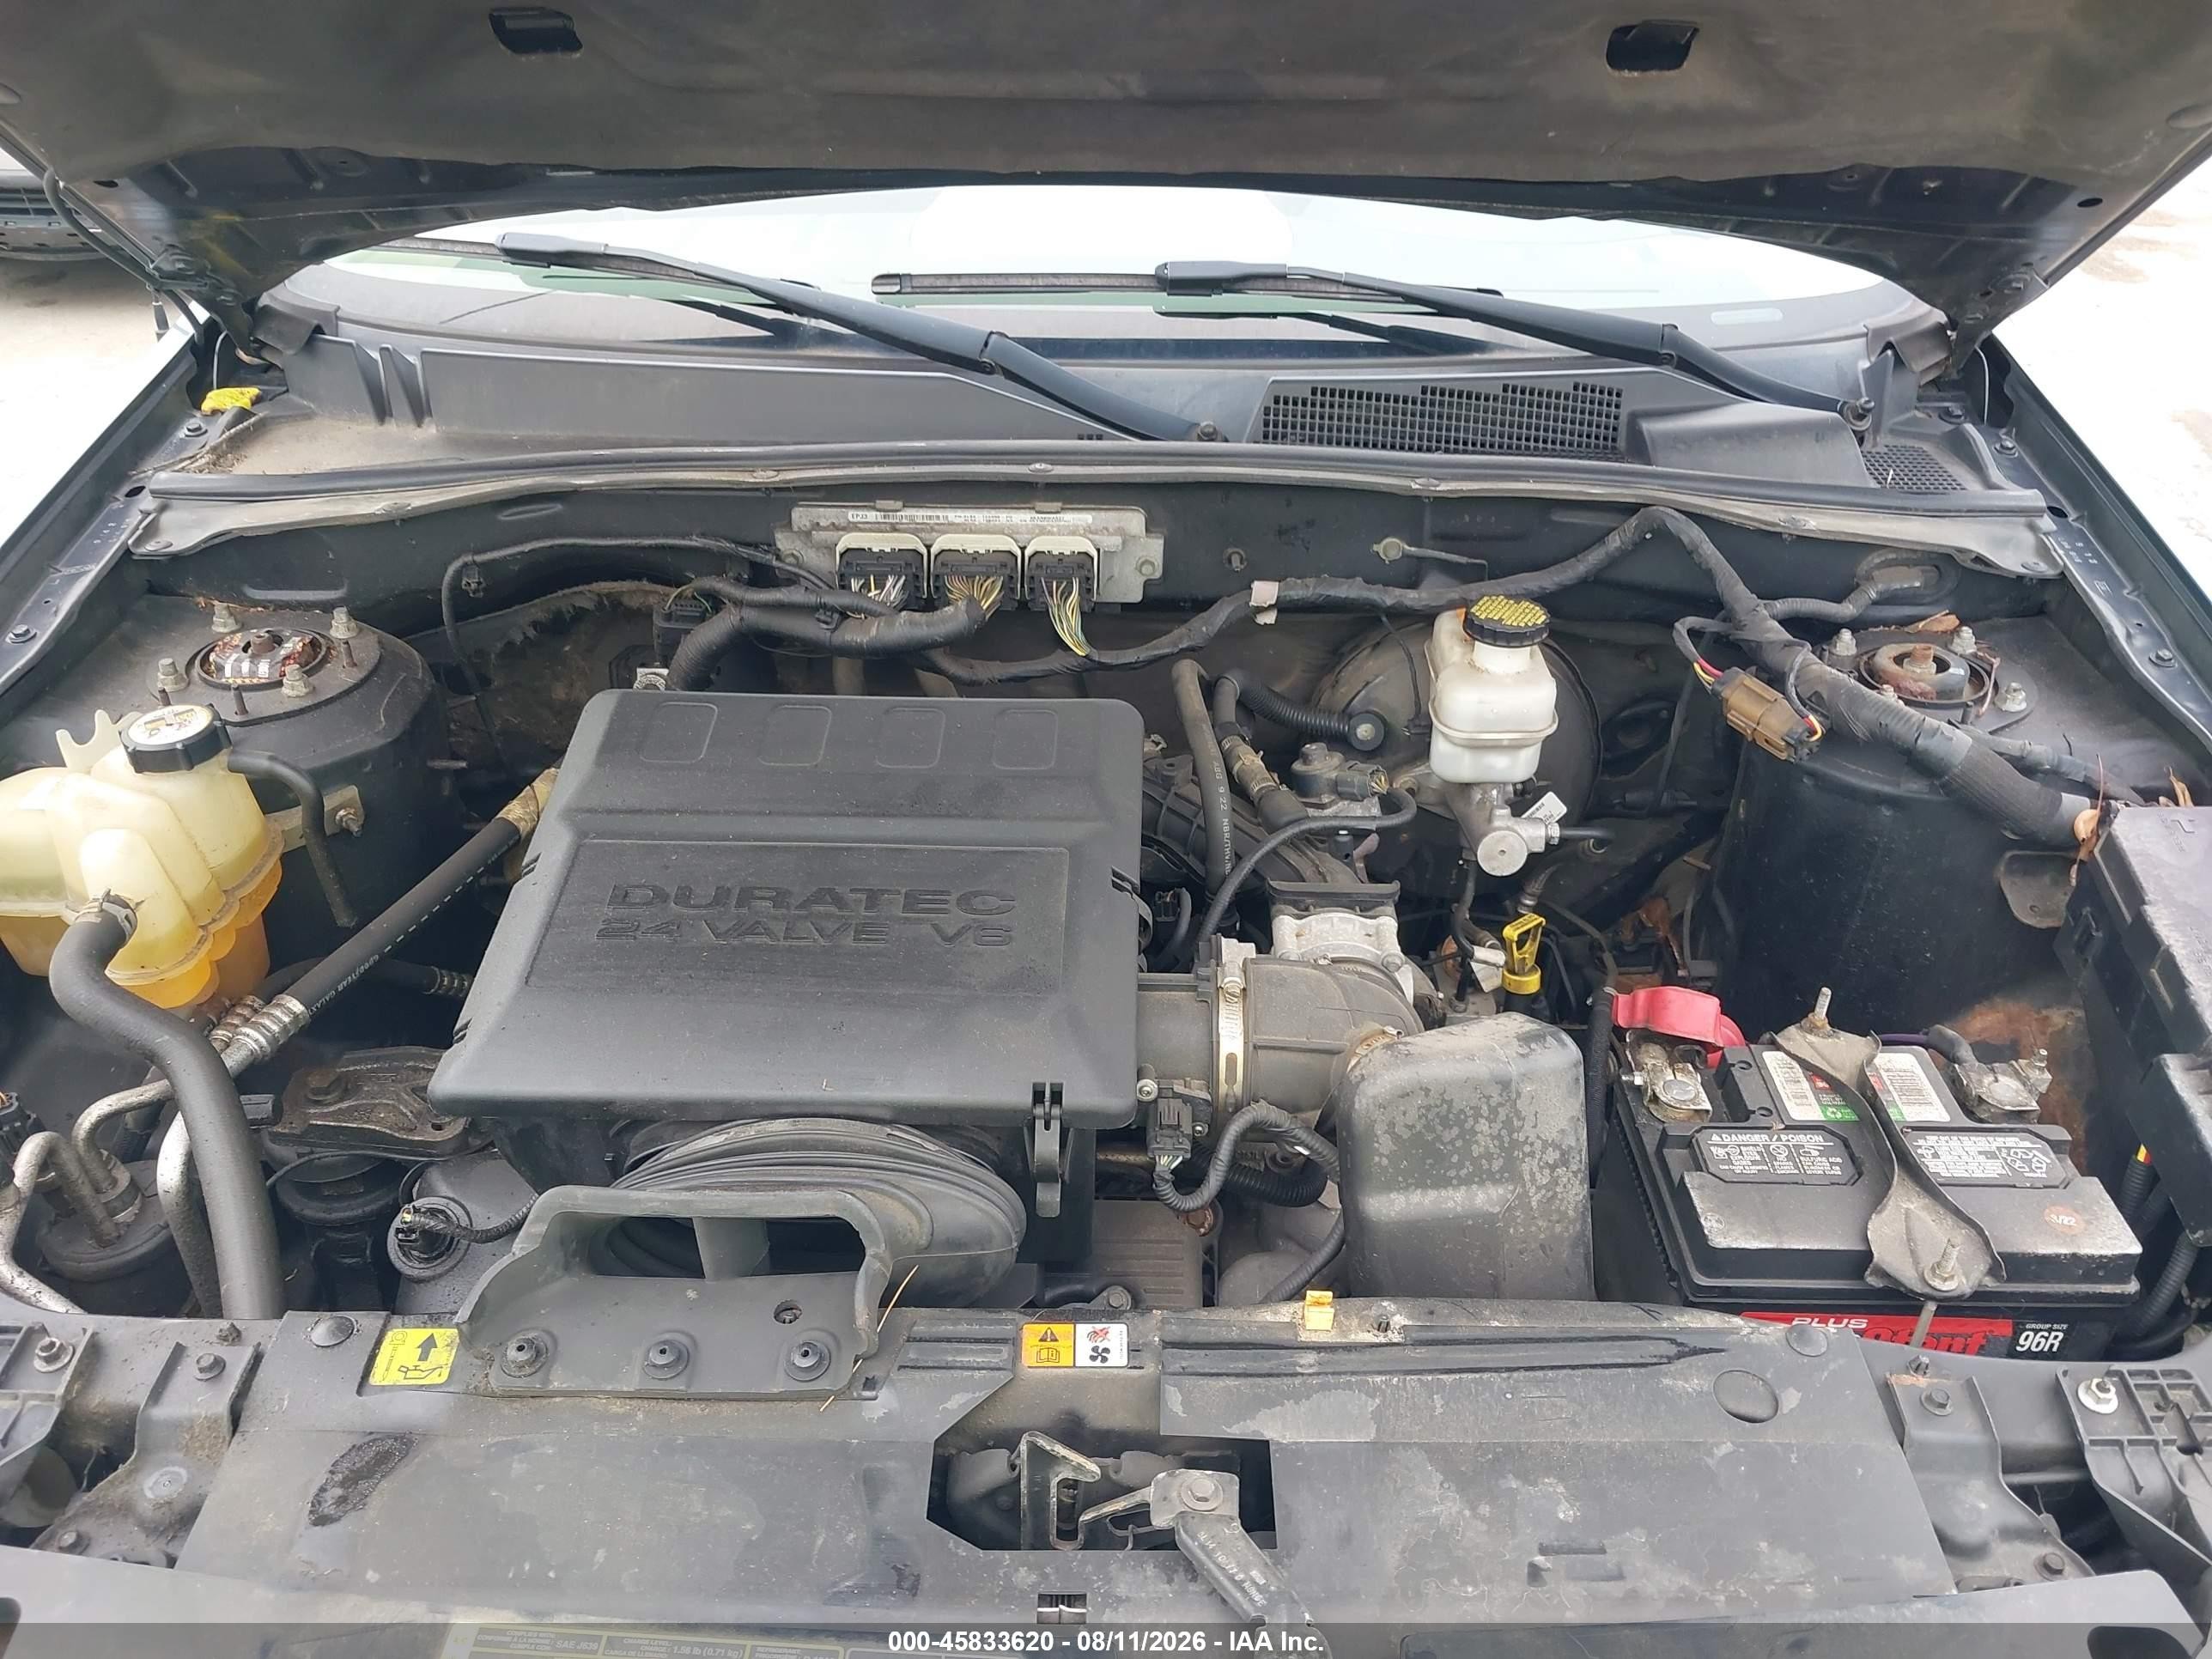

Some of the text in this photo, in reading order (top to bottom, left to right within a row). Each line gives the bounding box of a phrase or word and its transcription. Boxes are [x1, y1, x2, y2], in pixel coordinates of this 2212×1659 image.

[605, 883, 1016, 915] DURATEC
[595, 919, 1013, 946] 24 VALVE V6
[1721, 1133, 1770, 1143] DANGER
[1781, 1134, 1824, 1143] POISON
[1791, 1316, 1869, 1329] PLUS
[2015, 1331, 2064, 1352] 96R
[556, 1640, 599, 1651] SAE J639
